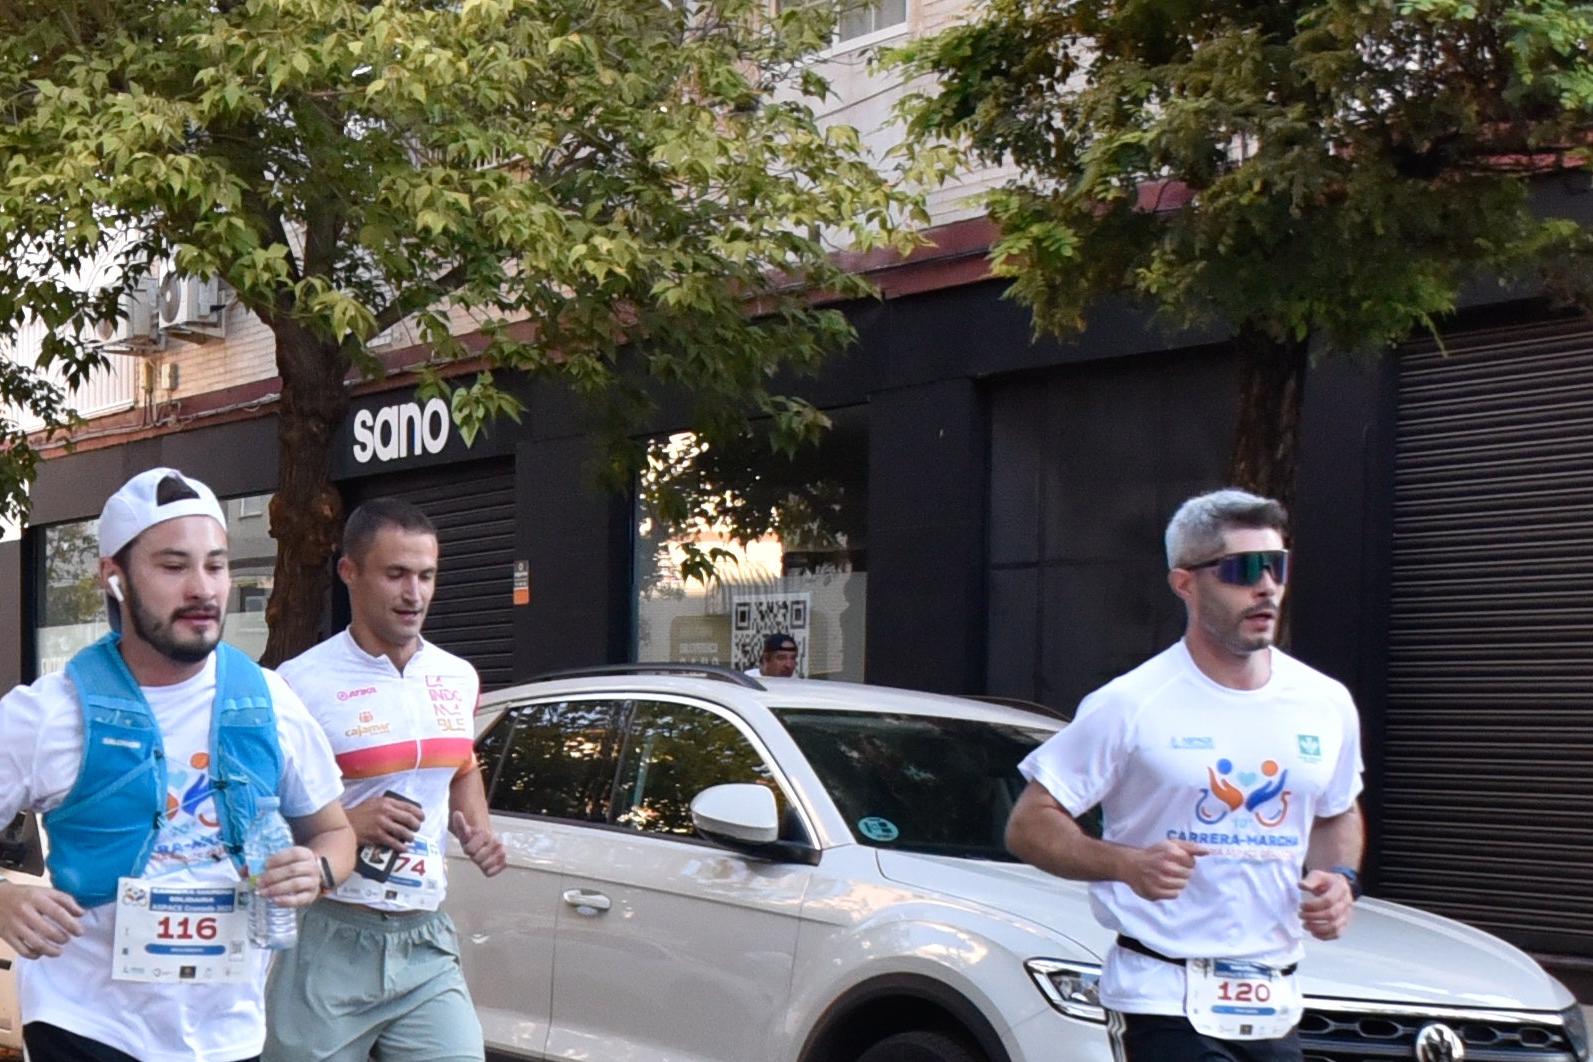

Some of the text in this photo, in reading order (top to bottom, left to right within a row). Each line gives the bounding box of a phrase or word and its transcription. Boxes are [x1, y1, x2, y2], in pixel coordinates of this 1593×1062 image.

[353, 397, 449, 463] sano
[157, 916, 217, 940] 116
[1218, 981, 1271, 1003] 120
